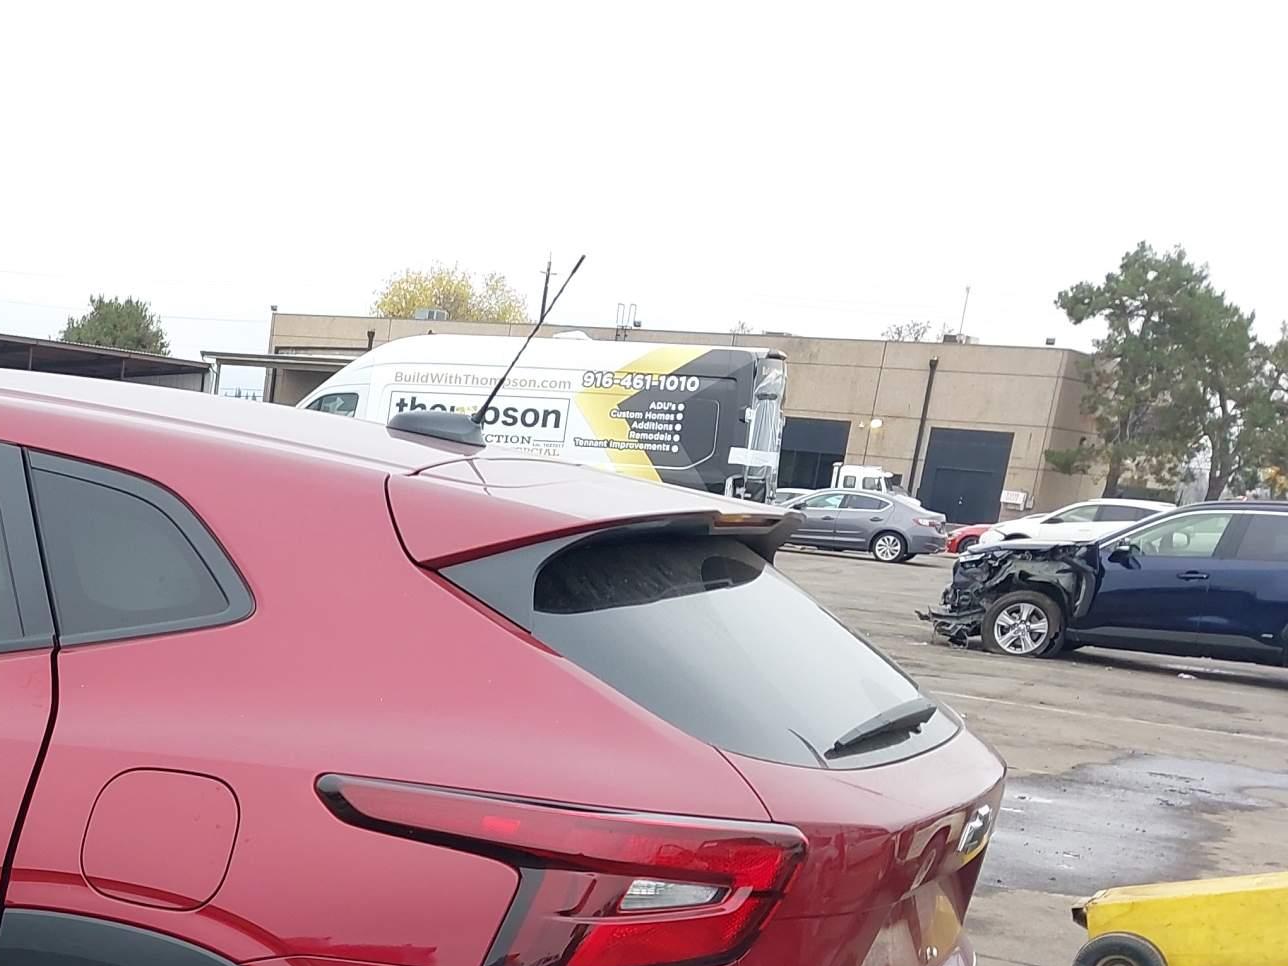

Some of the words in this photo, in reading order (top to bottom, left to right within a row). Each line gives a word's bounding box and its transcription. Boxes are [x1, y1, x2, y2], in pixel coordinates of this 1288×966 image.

[582, 371, 700, 392] 916-461-1010
[649, 401, 677, 411] ADU's
[396, 396, 562, 431] thpson
[610, 409, 643, 420] Custom
[644, 411, 675, 421] Homes
[631, 420, 673, 431] Additions
[629, 431, 672, 441] Remodels
[609, 440, 670, 452] Improvements
